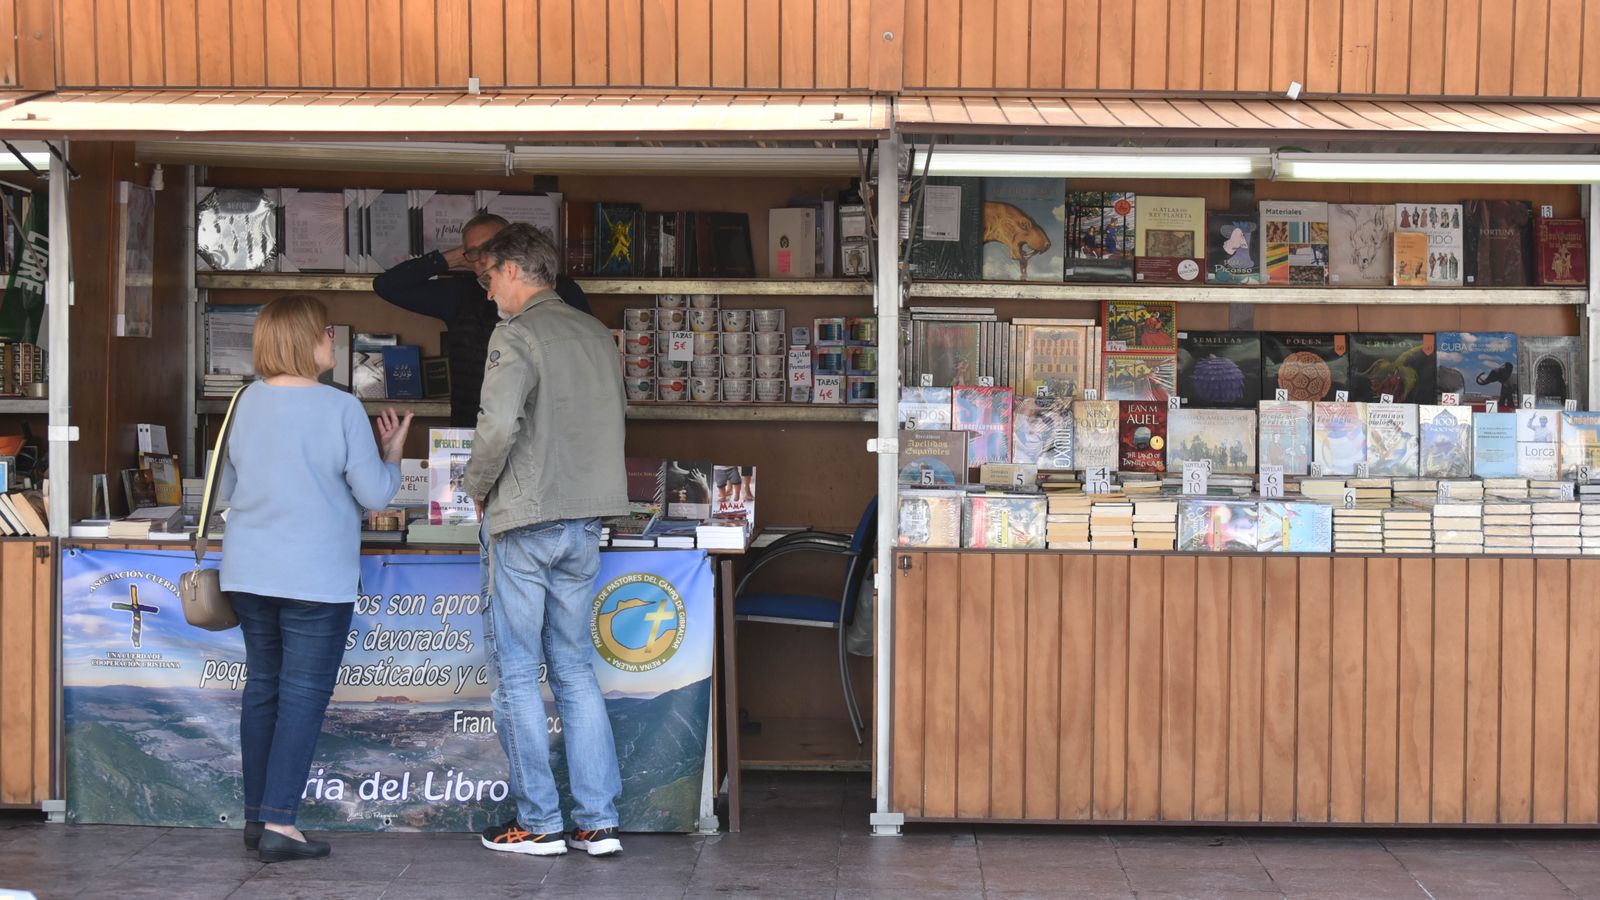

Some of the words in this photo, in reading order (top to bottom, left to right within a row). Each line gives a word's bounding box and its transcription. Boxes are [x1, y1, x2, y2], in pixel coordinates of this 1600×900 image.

[1265, 208, 1302, 216] Materiales
[1479, 228, 1515, 237] FORTUNY
[1215, 264, 1252, 275] Picasso
[673, 341, 687, 351] 5€
[1440, 342, 1467, 351] CUBA
[789, 351, 811, 360] Cajitas
[794, 371, 806, 381] 5€
[817, 378, 839, 386] TAZAS
[819, 389, 833, 400] 4€
[1038, 387, 1047, 396] 5
[1085, 390, 1095, 400] 10
[1278, 390, 1286, 400] 8
[1338, 392, 1345, 402] 8
[1170, 398, 1178, 408] 8
[1442, 394, 1456, 404] 25
[1524, 396, 1532, 408] 6
[1128, 404, 1147, 413] JEAN
[1486, 402, 1495, 413] 7
[907, 416, 916, 429] 5
[1126, 414, 1159, 424] AUEL
[907, 440, 949, 448] Apellidos
[905, 448, 950, 456] Españoles
[1525, 446, 1555, 457] Lorca
[923, 472, 932, 484] 5
[1095, 467, 1108, 479] 4
[1190, 470, 1201, 480] 6
[1580, 466, 1588, 479] 8
[1016, 474, 1024, 485] 5
[1267, 473, 1277, 484] 6
[407, 482, 418, 491] ÉL
[1093, 481, 1109, 493] 10
[1188, 482, 1201, 493] 10
[1264, 486, 1278, 497] 10
[456, 495, 470, 504] 3€
[1344, 490, 1353, 503] 6
[90, 570, 145, 593] ASOCIACIÓN
[607, 574, 642, 592] PASTORES
[643, 575, 658, 583] DEL
[599, 591, 608, 600] DE
[658, 580, 679, 600] CAMPO
[386, 593, 426, 615] son
[675, 599, 684, 610] DE
[590, 600, 602, 648] FRATERNIDAD
[672, 611, 685, 649] GIBRALTAR
[363, 623, 474, 653] devorados,
[121, 652, 151, 660] CUERDA
[91, 659, 141, 668] COOPERACIÓN
[141, 661, 181, 669] CRISTIANA
[611, 659, 639, 671] VALERA
[639, 659, 662, 671] REINA
[454, 665, 473, 694] y
[301, 768, 344, 800] ria
[358, 771, 410, 800] del
[424, 769, 509, 801] Libro
